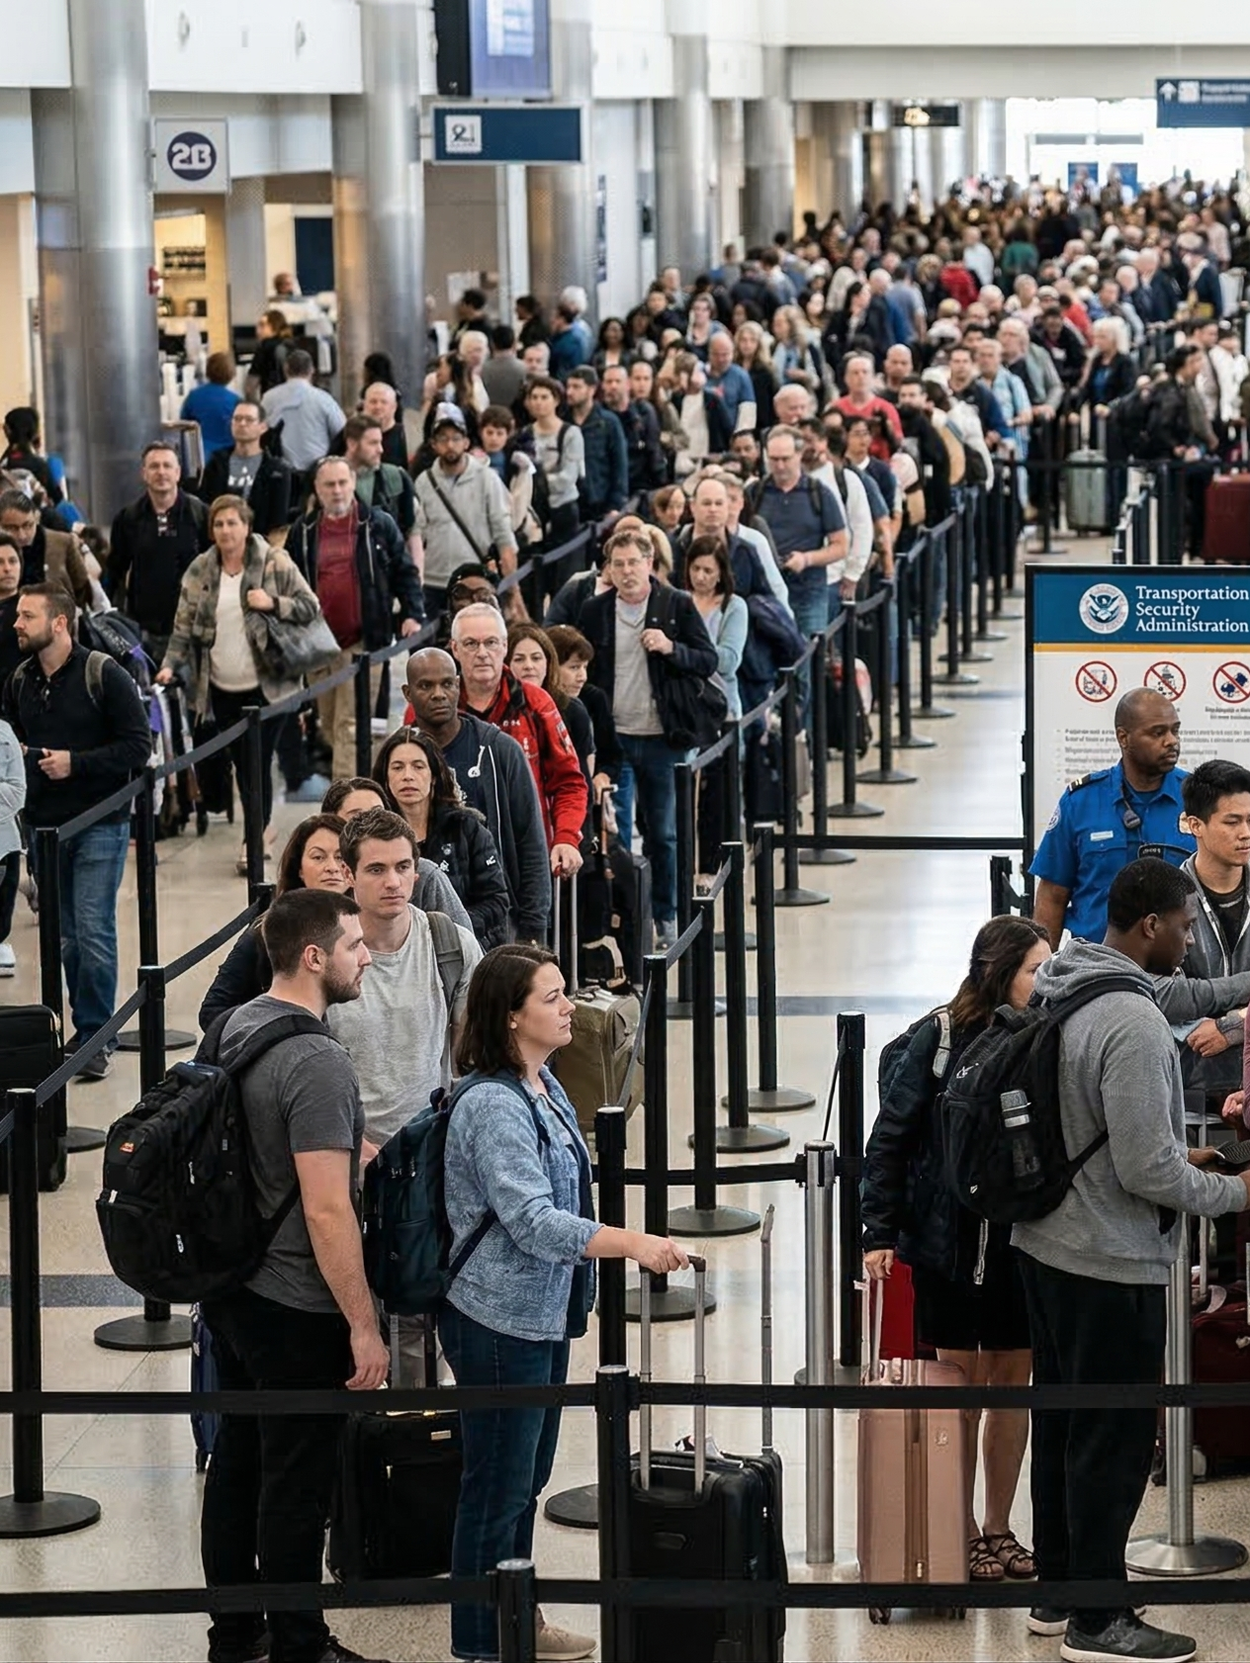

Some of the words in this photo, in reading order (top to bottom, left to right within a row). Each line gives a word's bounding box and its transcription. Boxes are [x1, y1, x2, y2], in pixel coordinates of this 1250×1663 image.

[1135, 586, 1250, 605] Transportation
[1135, 602, 1201, 620] Security
[1135, 617, 1250, 633] Administration
